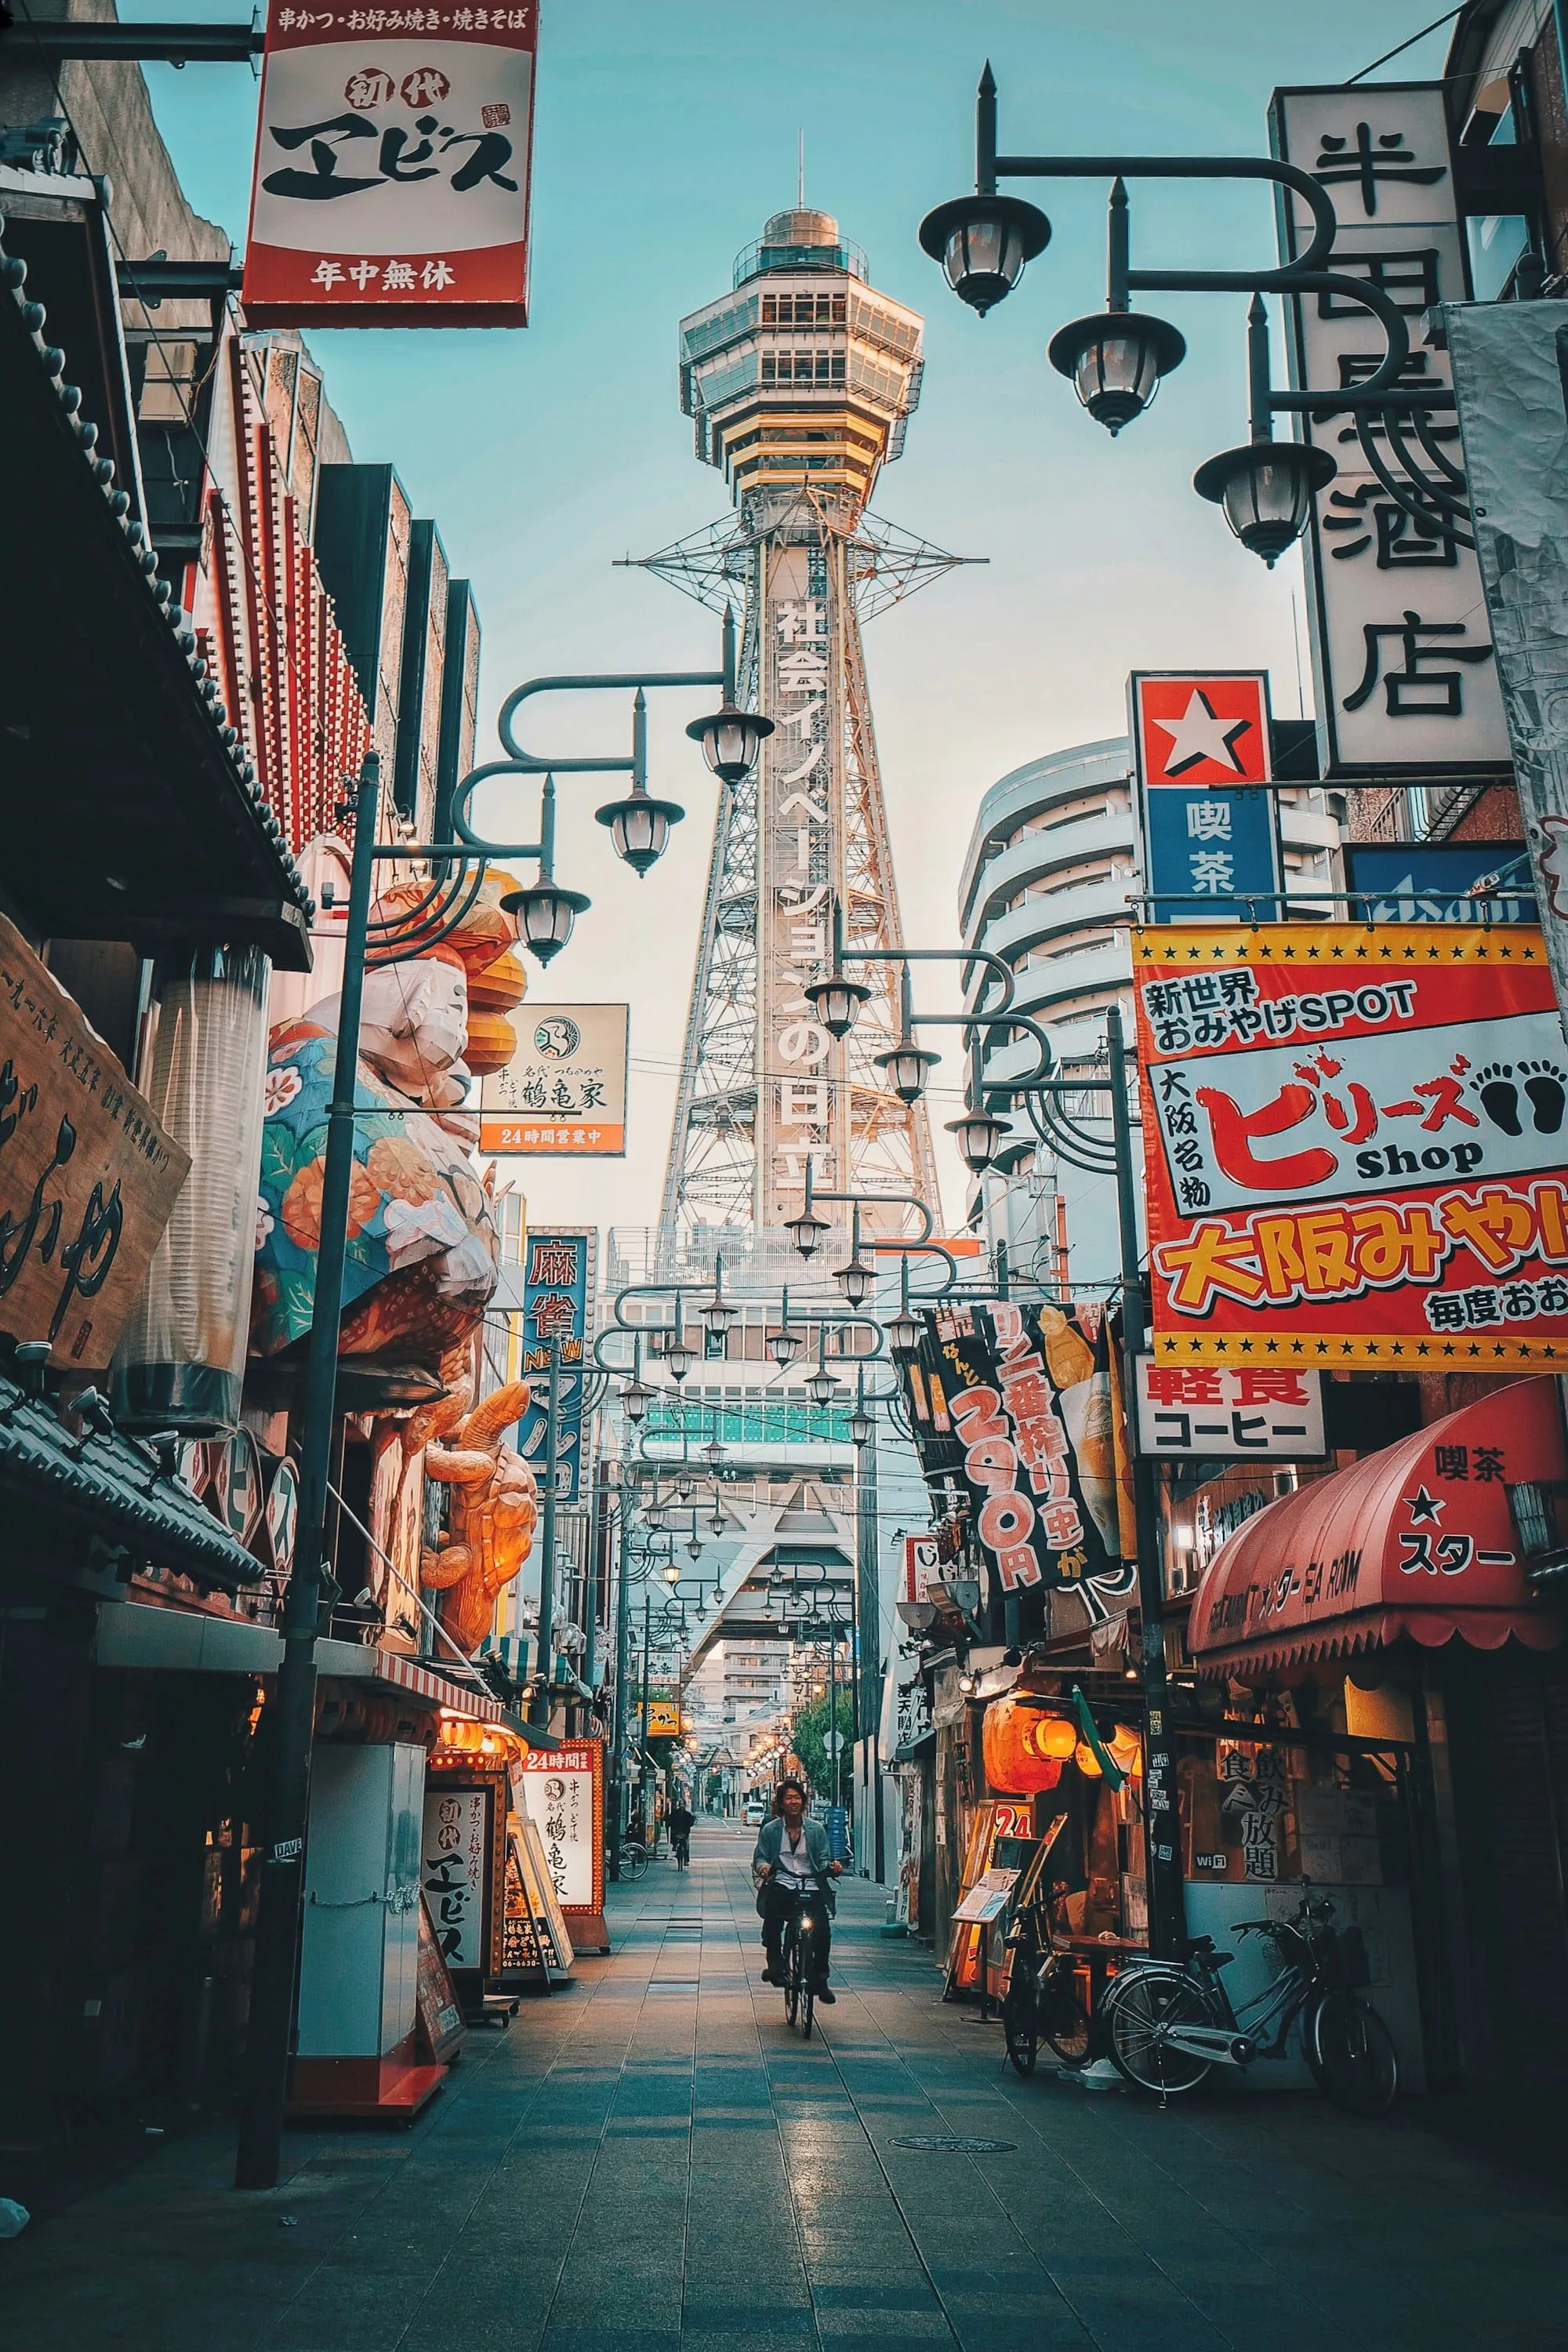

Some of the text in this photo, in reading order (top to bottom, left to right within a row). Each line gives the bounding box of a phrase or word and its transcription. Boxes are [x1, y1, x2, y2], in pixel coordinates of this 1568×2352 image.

[278, 7, 528, 31] 串かつ・お好み焼き・焼きそば
[310, 260, 457, 292] 年中無休
[1185, 801, 1236, 894] 喫茶
[1145, 970, 1256, 1018] 新世界
[1158, 982, 1415, 1052] おみやげSPOT
[501, 1128, 603, 1145] 24時間営業中
[1160, 1069, 1211, 1208] 大阪名物
[528, 1240, 579, 1338] 麻雀
[1145, 1363, 1311, 1406] 軽食
[1154, 1411, 1307, 1447] コーヒー
[1435, 1445, 1506, 1483] 喫茶
[1399, 1532, 1516, 1576] スター
[1243, 1813, 1278, 1881] 放題
